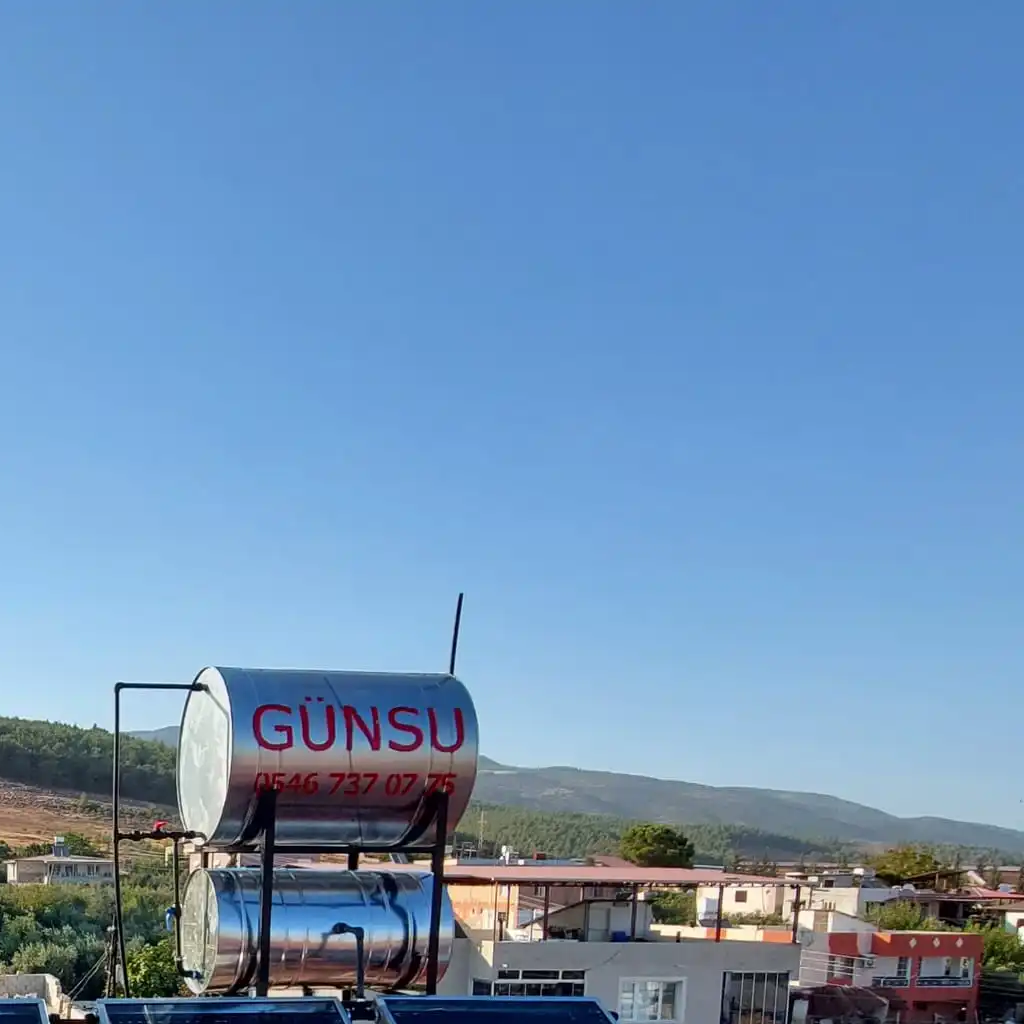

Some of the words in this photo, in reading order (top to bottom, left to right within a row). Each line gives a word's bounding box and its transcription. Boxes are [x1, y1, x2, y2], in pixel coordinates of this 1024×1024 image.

[252, 696, 464, 751] GÜNSU
[329, 773, 380, 795] 737
[385, 773, 419, 796] 07
